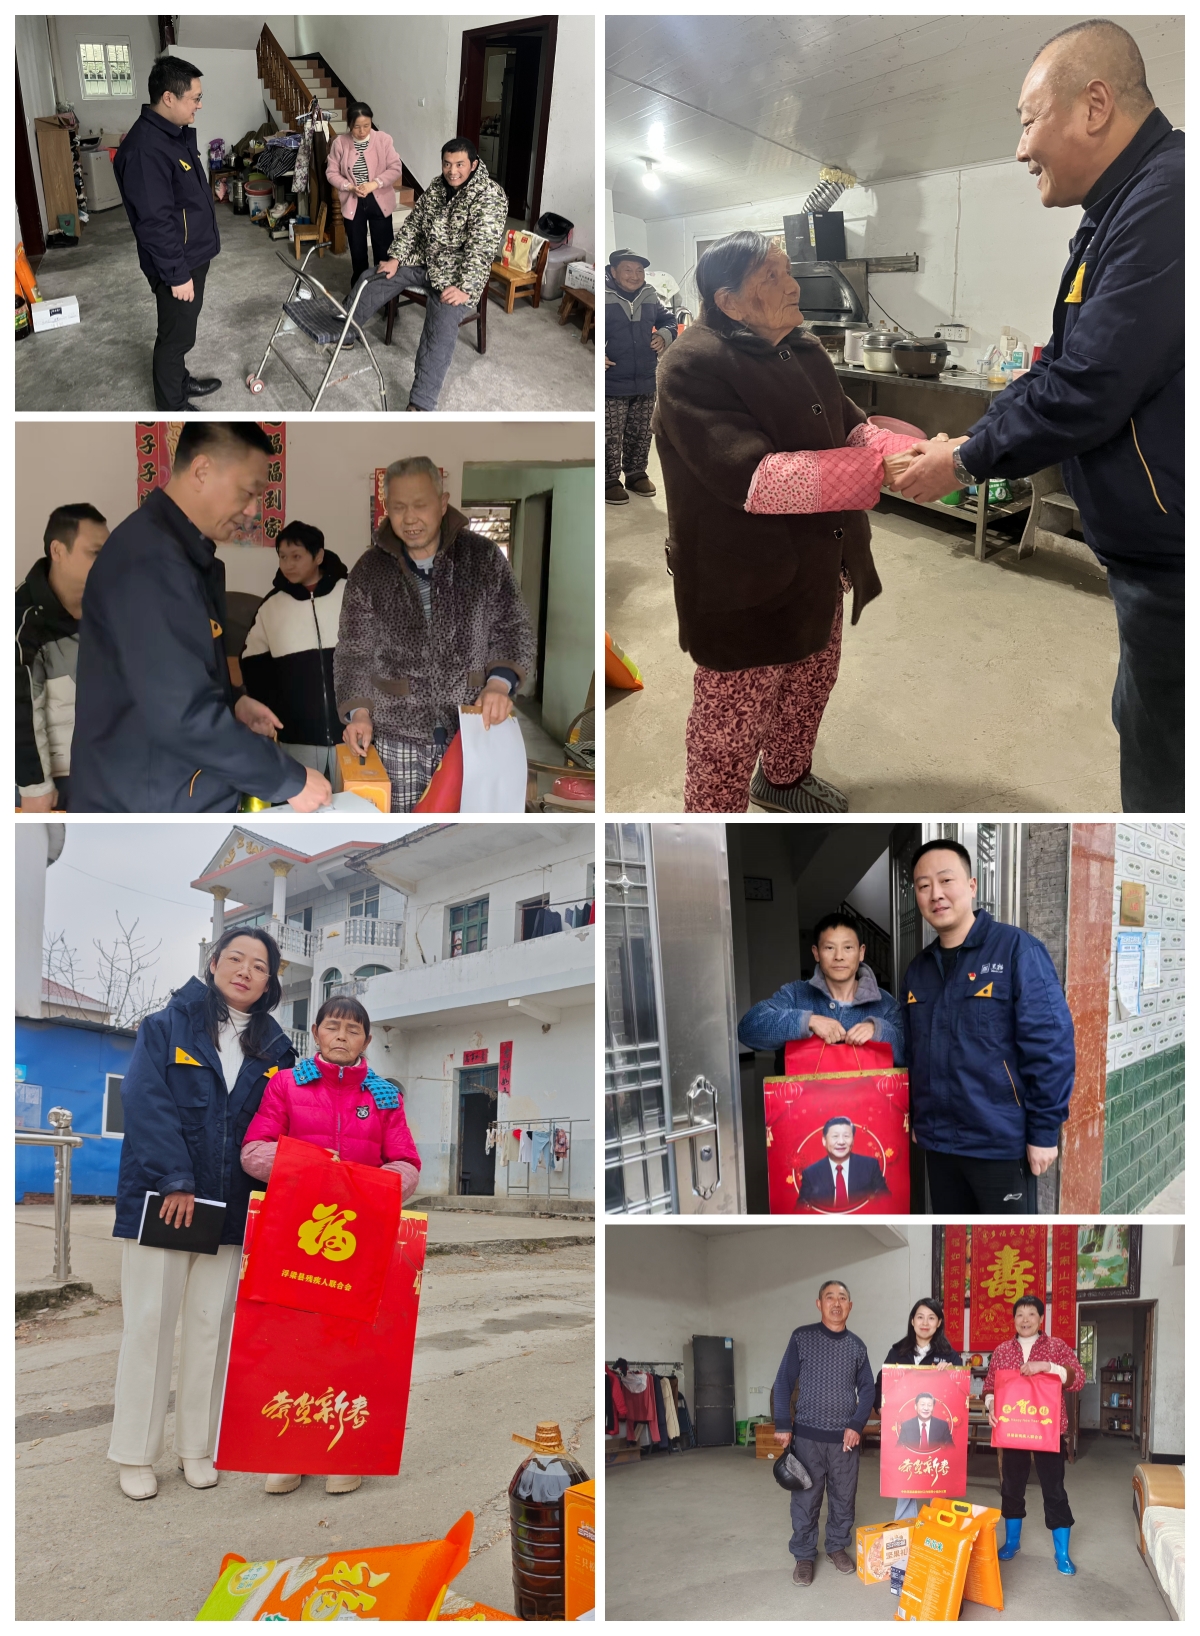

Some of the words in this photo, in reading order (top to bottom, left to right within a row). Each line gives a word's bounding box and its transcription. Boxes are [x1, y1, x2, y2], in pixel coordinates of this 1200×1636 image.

[297, 1203, 357, 1262] 福
[281, 1268, 352, 1292] 浮梁县残疾人联合会
[261, 1386, 370, 1453] 恭贺新春
[898, 1456, 950, 1488] 恭贺新春
